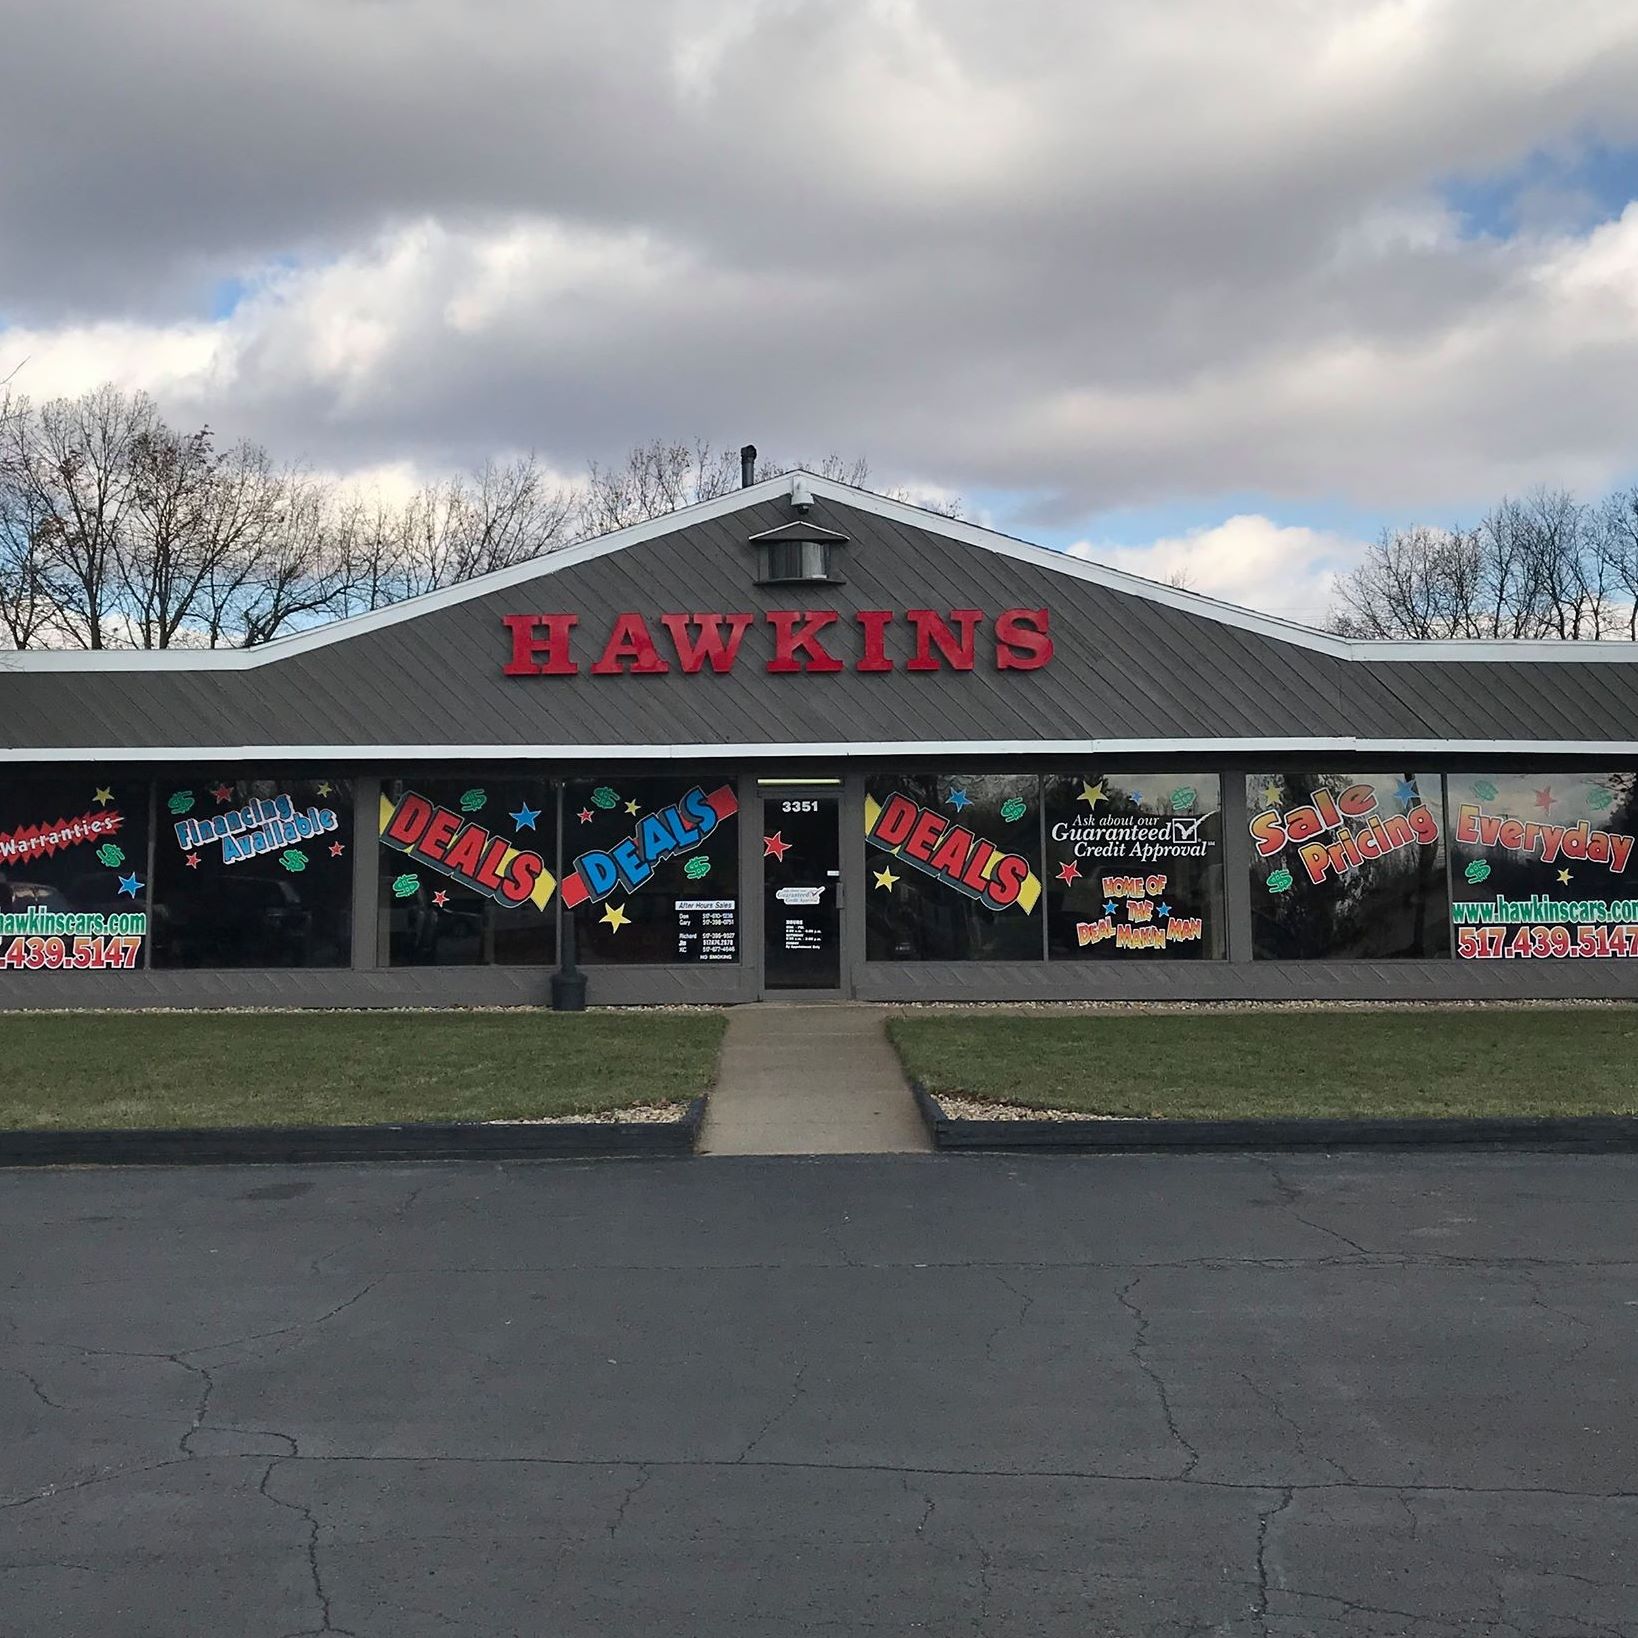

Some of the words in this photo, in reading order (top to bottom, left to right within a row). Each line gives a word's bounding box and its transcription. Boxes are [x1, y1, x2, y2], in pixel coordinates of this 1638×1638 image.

[503, 608, 1054, 676] HAWKINS
[174, 793, 294, 850] Financing
[782, 800, 819, 813] 3351
[1072, 813, 1095, 826] Ask
[1099, 814, 1134, 826] about
[1137, 816, 1160, 826] our
[1249, 784, 1379, 856] Sale
[0, 817, 118, 858] Warranties
[222, 807, 339, 865] Available
[381, 791, 545, 906] DEALS
[576, 785, 719, 901] DEALS
[868, 791, 1030, 908] DEALS
[1051, 822, 1172, 842] Guaranteed
[1074, 841, 1126, 858] Credit
[1129, 841, 1207, 862] Approval
[1298, 804, 1439, 884] Pricing
[1456, 803, 1635, 873] Everyday
[1102, 876, 1145, 898] HOME
[1145, 874, 1167, 896] OF
[1076, 916, 1116, 946] DEAL
[1166, 917, 1202, 942] MAN
[1126, 900, 1154, 923] THE
[1458, 925, 1638, 959] 517.439.5147
